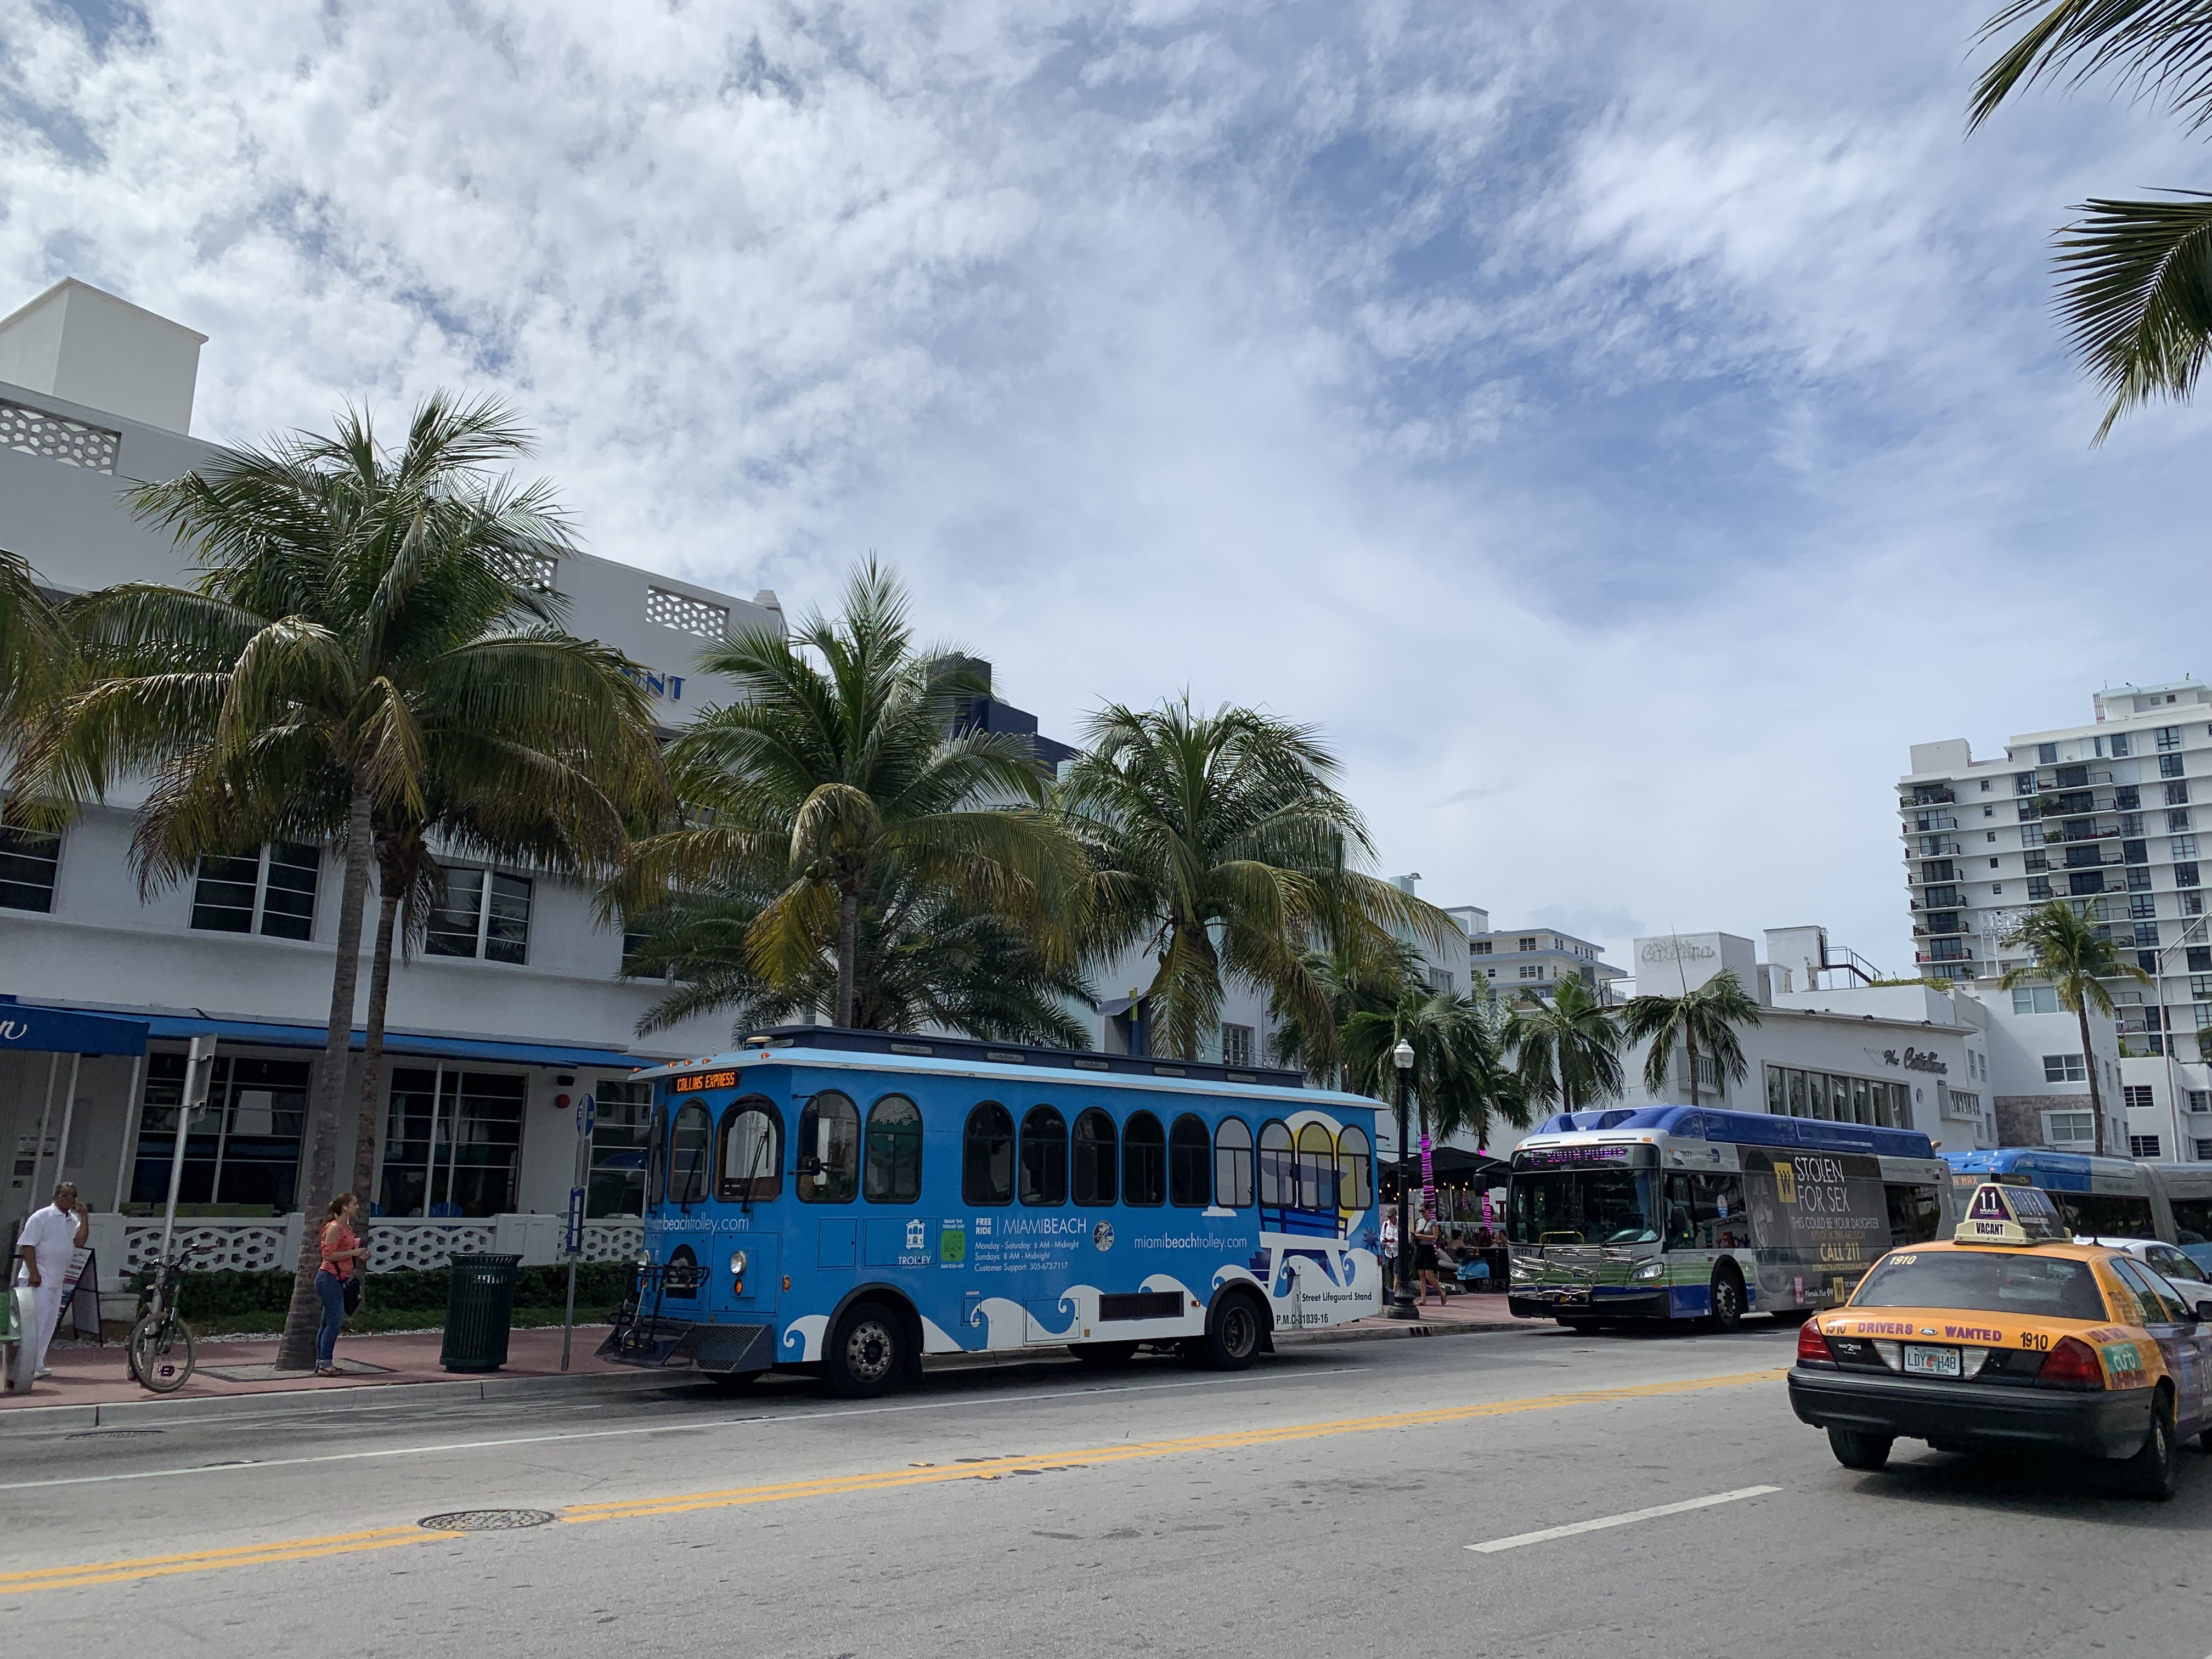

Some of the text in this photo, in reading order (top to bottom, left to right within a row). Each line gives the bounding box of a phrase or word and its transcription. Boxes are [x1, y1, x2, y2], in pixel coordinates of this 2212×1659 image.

[1884, 1047, 1948, 1074] The Catalina
[677, 1072, 735, 1092] COLLINS EXPRESS
[1795, 1156, 1845, 1183] STOLEN
[1961, 1176, 1978, 1186] MAX
[1798, 1185, 1850, 1212] FOR SEX
[1980, 1191, 1996, 1209] 11
[1791, 1216, 1880, 1229] THIS COULD BE YOUR DAUGHTER
[1976, 1222, 2004, 1235] VACANT
[975, 1241, 1000, 1251] Monday
[1005, 1241, 1032, 1251] Saturday:
[1054, 1239, 1079, 1250] Midnight
[1134, 1232, 1247, 1252] miamibeachtrolley.com
[1024, 1251, 1050, 1262] Midnight
[1513, 1248, 1532, 1256] 18171
[1820, 1242, 1860, 1262] CALL 211
[898, 1256, 931, 1265] TROLLEY
[1889, 1255, 1917, 1265] 1910
[974, 1263, 1002, 1272] Customer
[1003, 1262, 1028, 1273] Support:
[1029, 1262, 1068, 1271] 305-673-7117
[1302, 1293, 1321, 1302] Street
[1322, 1292, 1353, 1303] Lifeguard
[1354, 1291, 1372, 1301] Stand
[1858, 1322, 1914, 1335] DRIVERS
[1944, 1325, 2002, 1342] WANTED
[2020, 1331, 2049, 1350] 1910
[1908, 1353, 1926, 1367] LDY
[2114, 1351, 2136, 1371] curb
